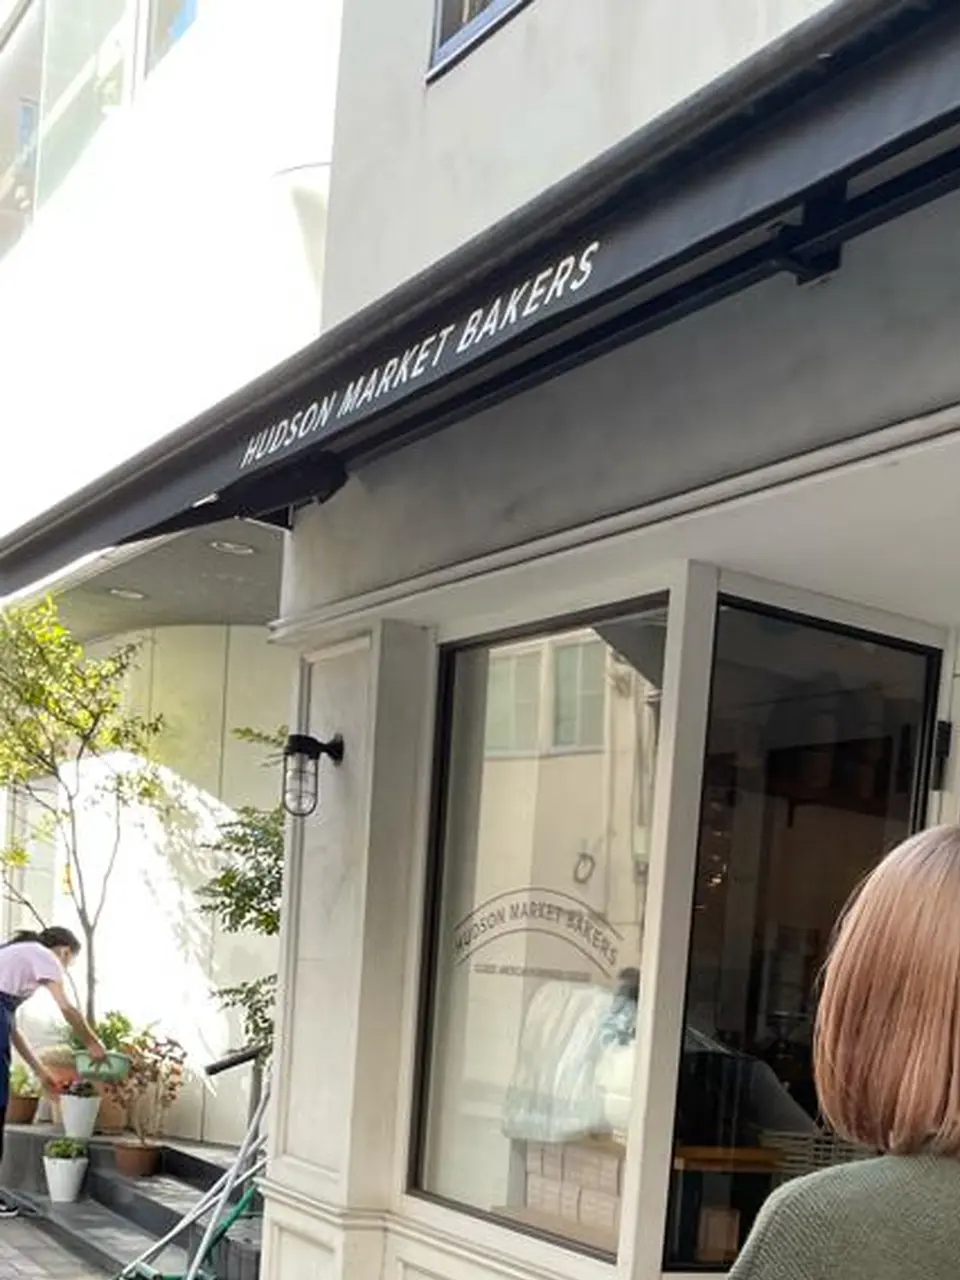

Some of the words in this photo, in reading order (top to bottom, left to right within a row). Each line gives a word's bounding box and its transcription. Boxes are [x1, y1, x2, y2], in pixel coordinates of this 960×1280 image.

[240, 391, 337, 468] HUDSON
[337, 324, 455, 417] MARKET
[456, 241, 600, 353] BAKERS
